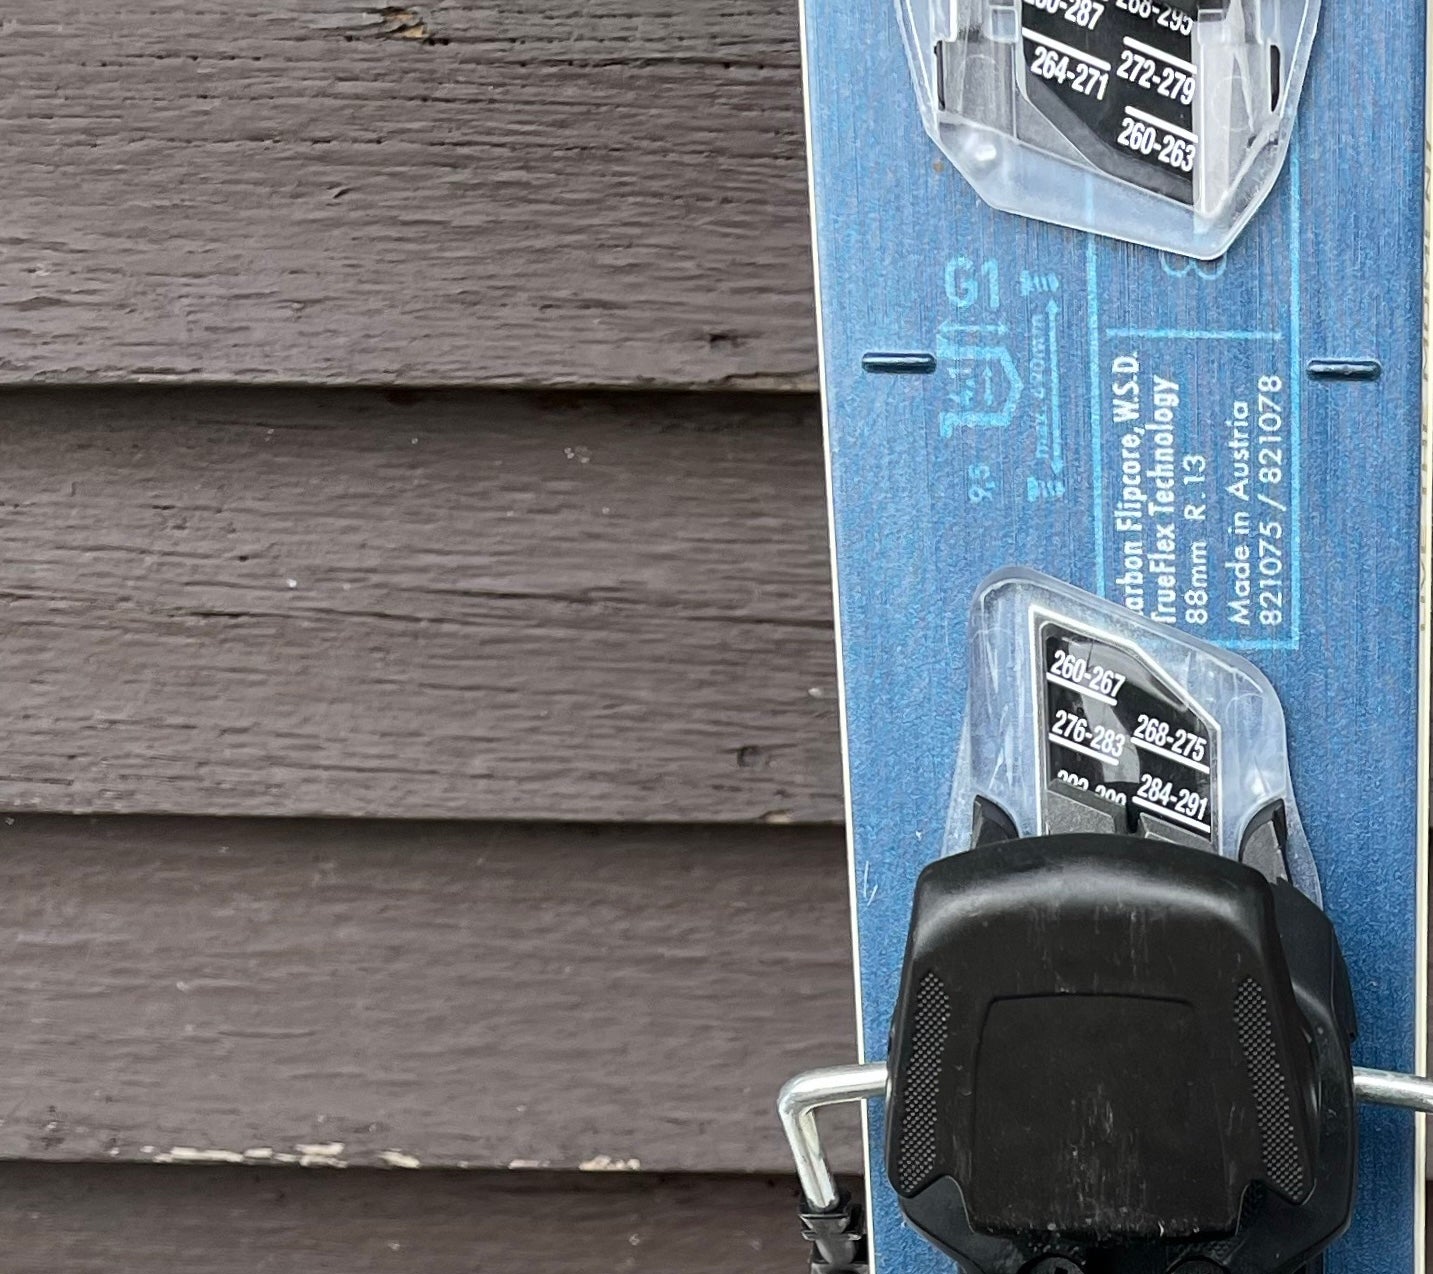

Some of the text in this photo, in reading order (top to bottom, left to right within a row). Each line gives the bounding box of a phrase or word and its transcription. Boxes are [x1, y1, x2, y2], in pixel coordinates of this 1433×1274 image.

[1030, 45, 1110, 101] 264-271
[1116, 50, 1196, 105] 272-279
[1117, 117, 1196, 173] 260-263
[943, 255, 1001, 311] G1
[1148, 375, 1180, 516] Technology
[1258, 375, 1283, 484] 821078
[1115, 425, 1148, 532] Flipcore,
[1225, 400, 1251, 626] Made in Austria
[1185, 540, 1209, 624] 88mm
[1258, 520, 1283, 626] 821075
[1050, 650, 1126, 697] 260-267
[1051, 710, 1126, 758] 276-283
[1133, 714, 1208, 762] 268-275
[1136, 774, 1209, 821] 284-291
